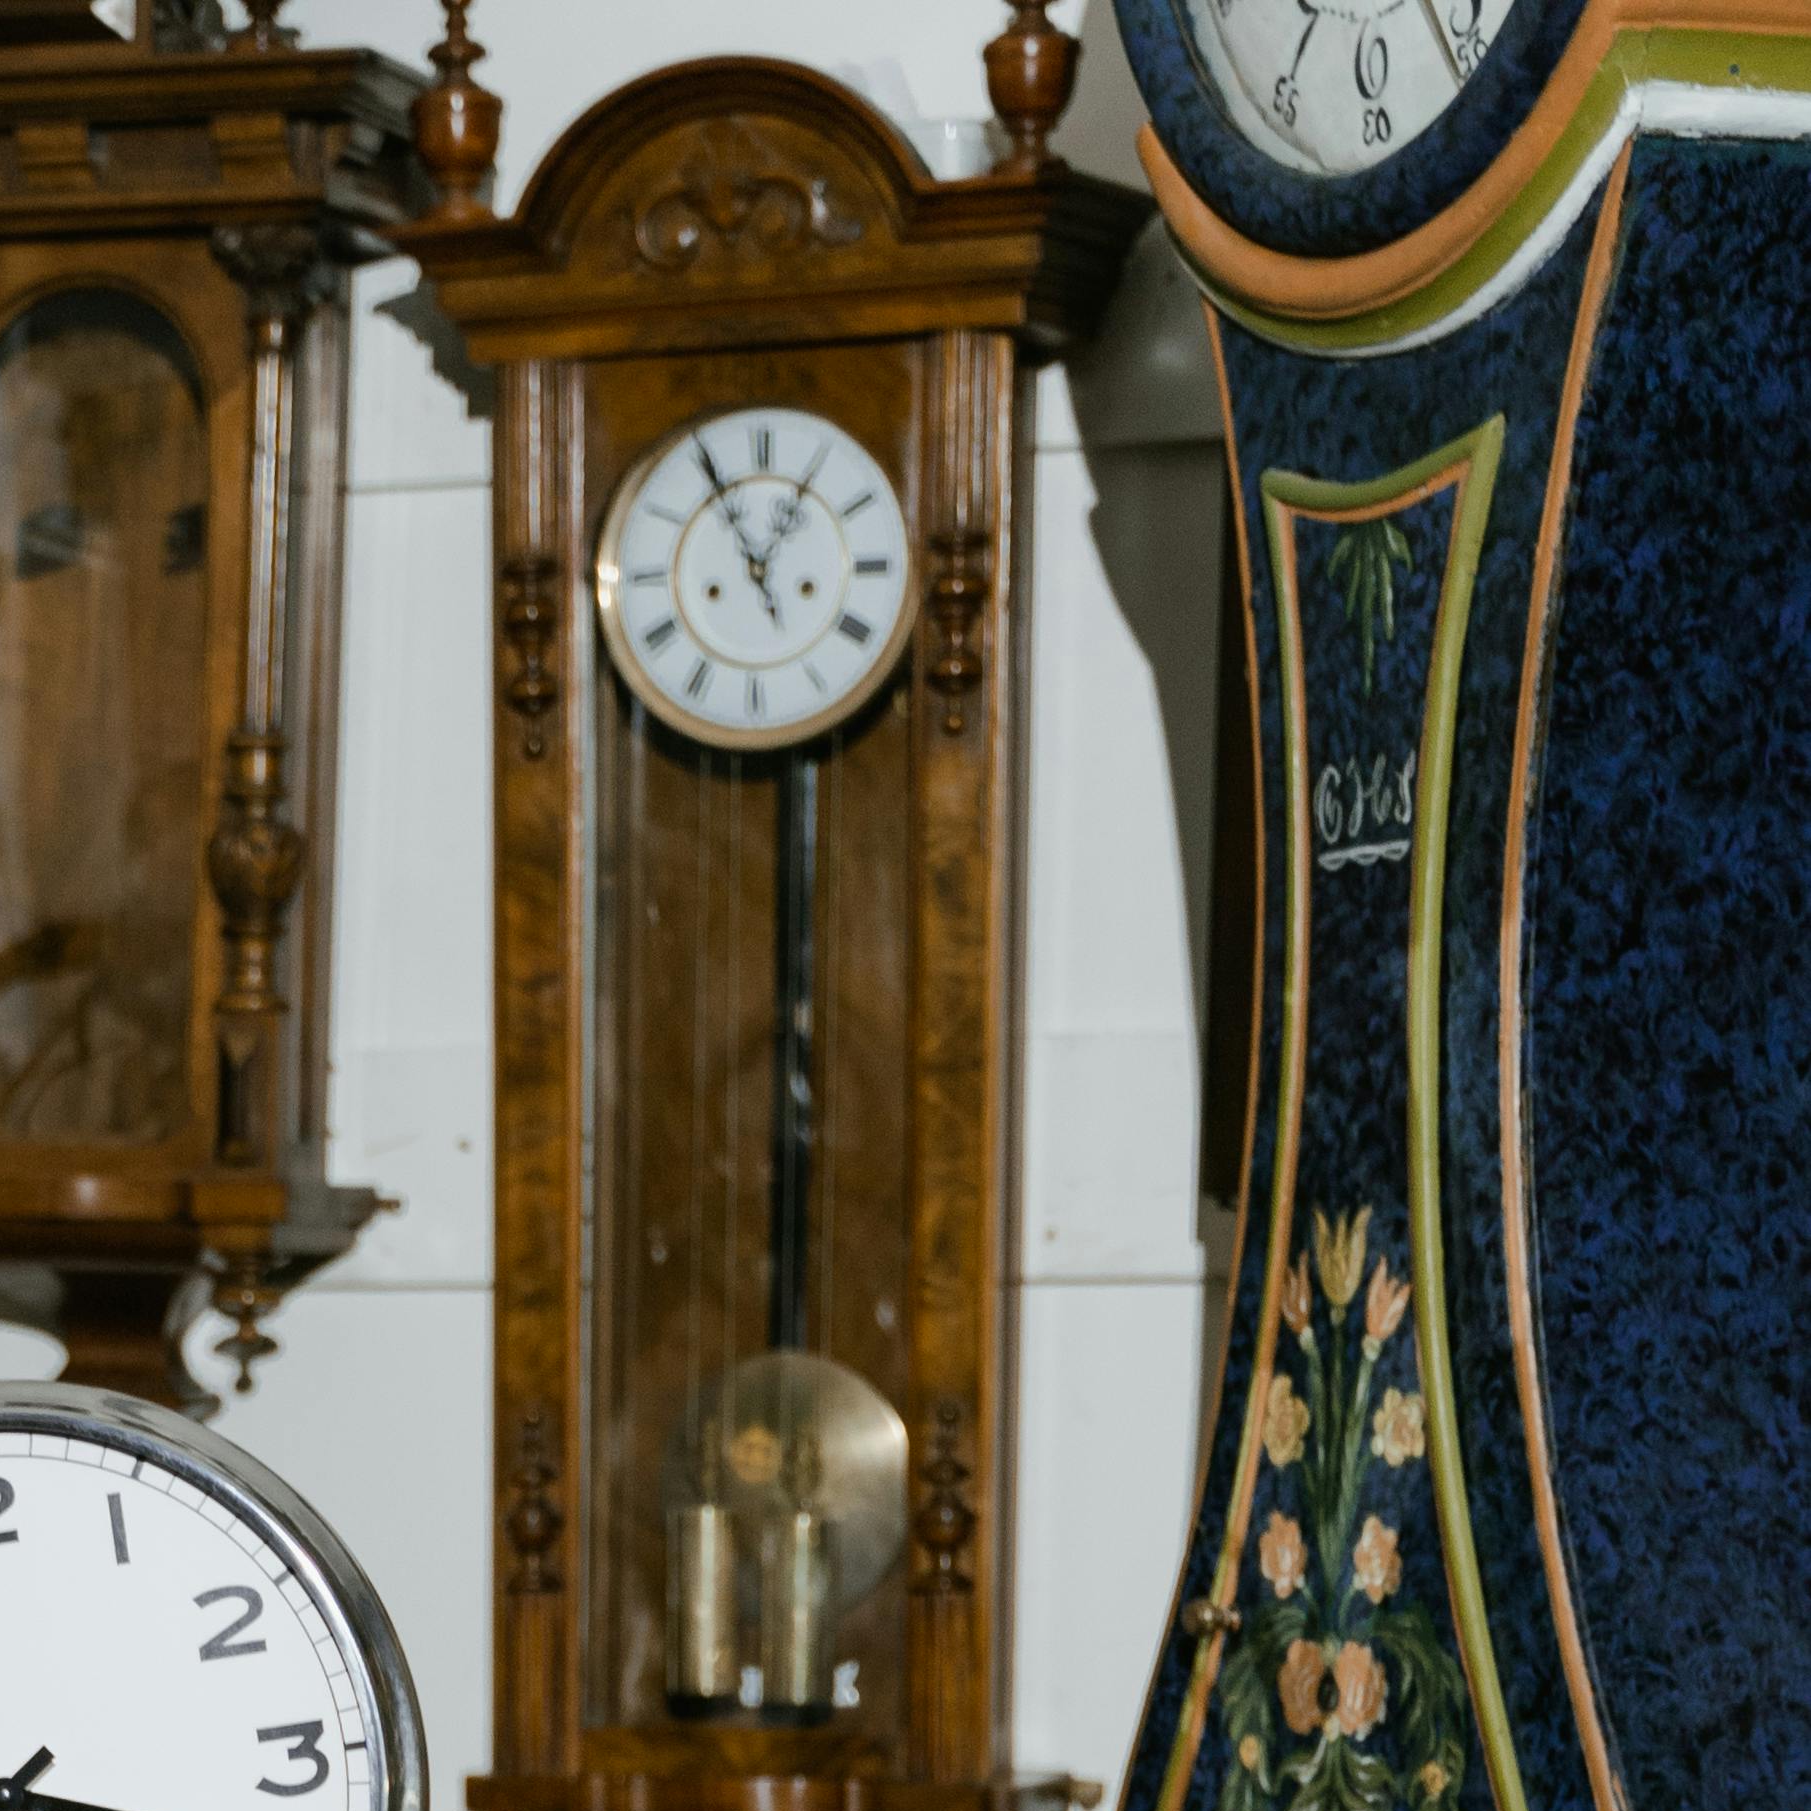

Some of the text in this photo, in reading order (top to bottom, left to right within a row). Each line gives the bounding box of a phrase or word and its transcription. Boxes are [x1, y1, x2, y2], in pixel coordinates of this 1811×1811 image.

[1354, 17, 1389, 100] 6
[107, 1492, 130, 1565] 1
[193, 1585, 267, 1662] 2
[255, 1719, 330, 1797] 3
